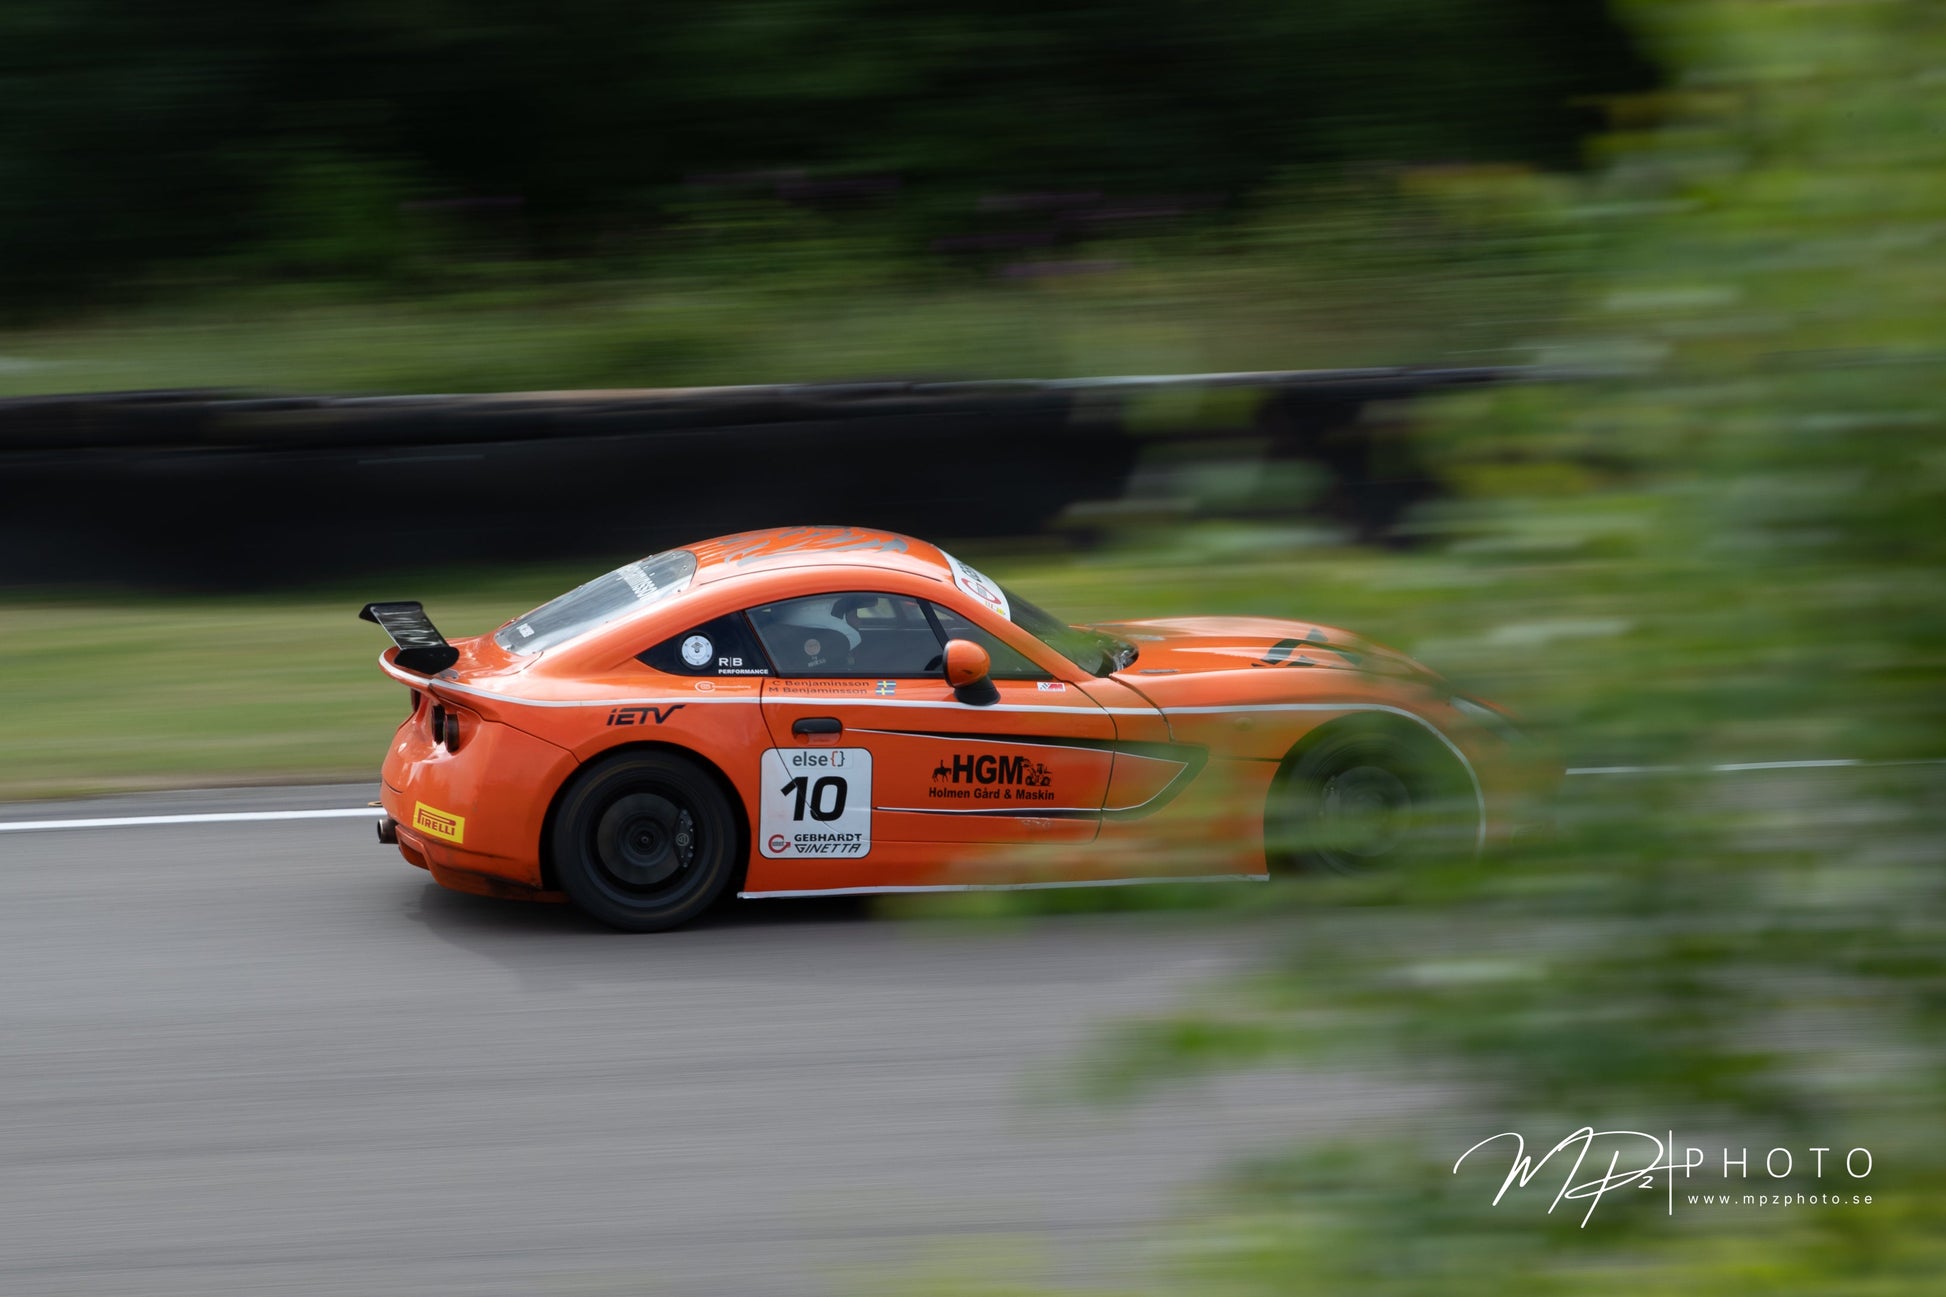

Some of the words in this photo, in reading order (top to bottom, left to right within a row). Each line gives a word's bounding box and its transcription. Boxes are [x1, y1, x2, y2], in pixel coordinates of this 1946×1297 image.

[952, 754, 1023, 785] HGM
[780, 776, 848, 821] 10
[929, 787, 970, 798] Holmen
[974, 787, 1000, 799] Gård
[1004, 789, 1012, 799] &
[1016, 789, 1055, 800] Maskin
[418, 808, 456, 836] PIRELLI
[794, 833, 862, 842] GEBHARDT
[795, 843, 862, 853] GINETTA
